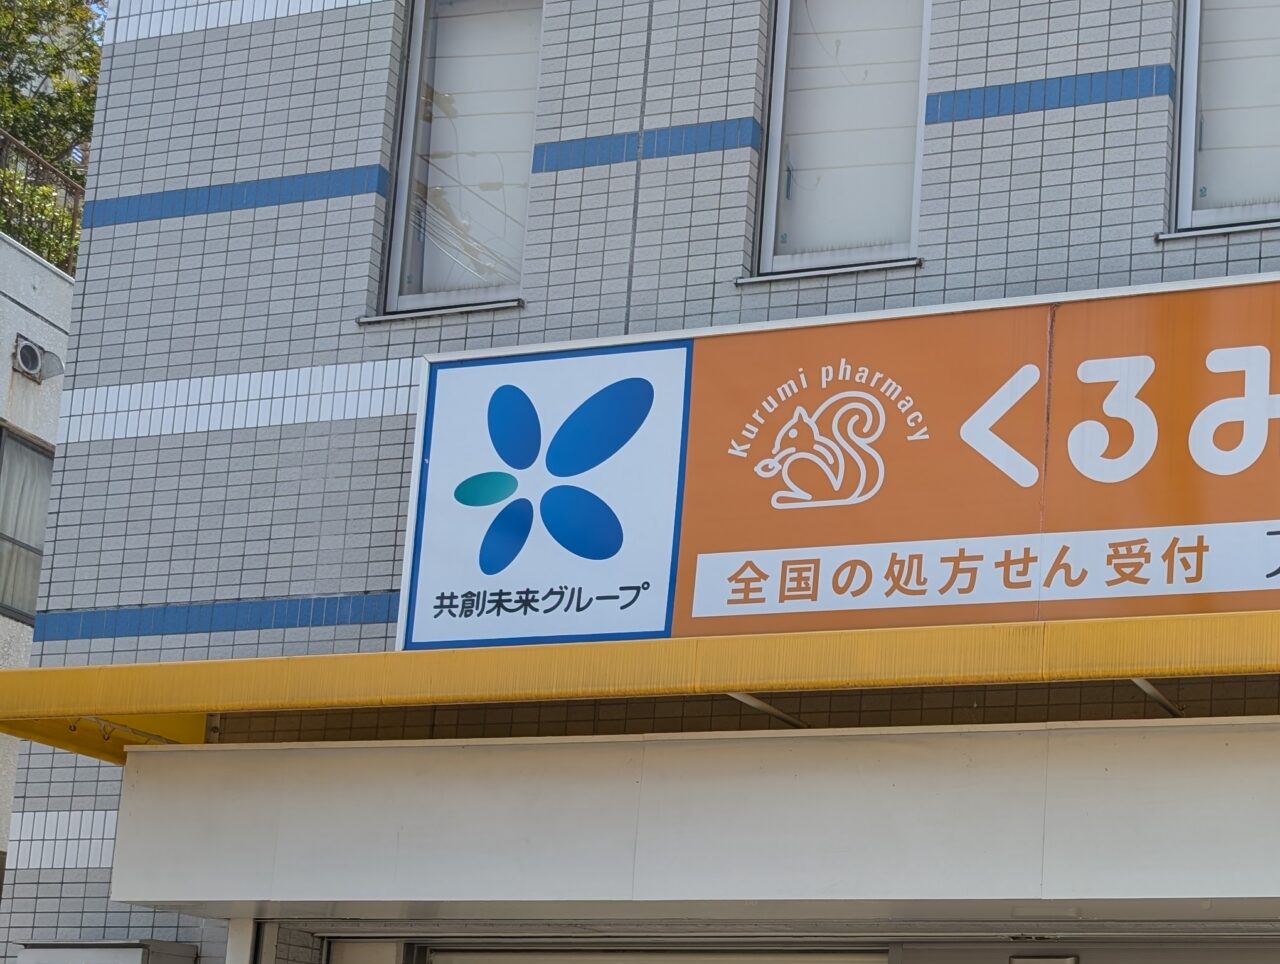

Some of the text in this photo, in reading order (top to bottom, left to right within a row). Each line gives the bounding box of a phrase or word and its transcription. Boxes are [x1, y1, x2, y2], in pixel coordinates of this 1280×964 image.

[726, 357, 930, 460] Kurumi pharmacy
[433, 581, 651, 620] 共創未来グループ
[726, 535, 1209, 606] 全国の処方せん受付
